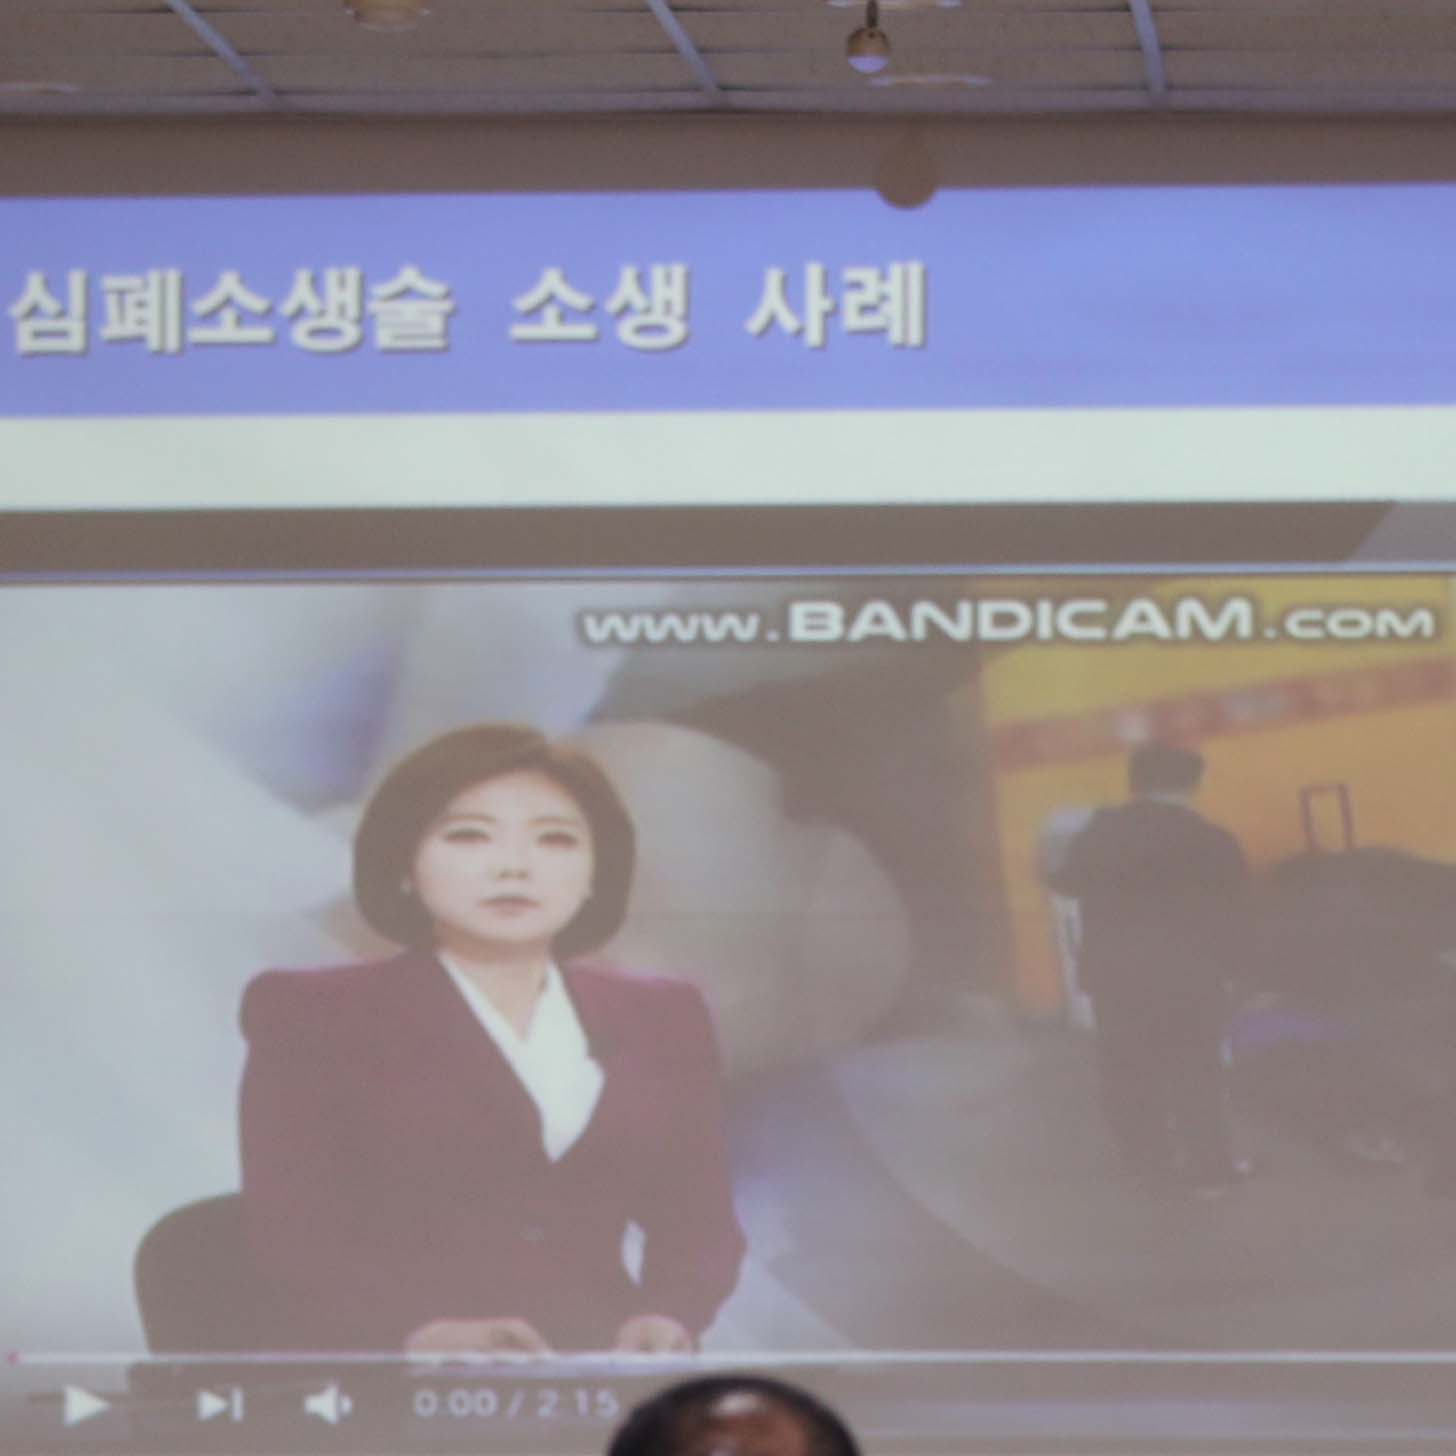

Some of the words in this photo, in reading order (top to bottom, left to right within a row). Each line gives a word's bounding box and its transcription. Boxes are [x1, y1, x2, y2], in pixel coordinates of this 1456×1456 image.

[7, 266, 456, 355] 심폐소생술
[508, 263, 691, 350] 소생
[746, 259, 928, 349] 사례
